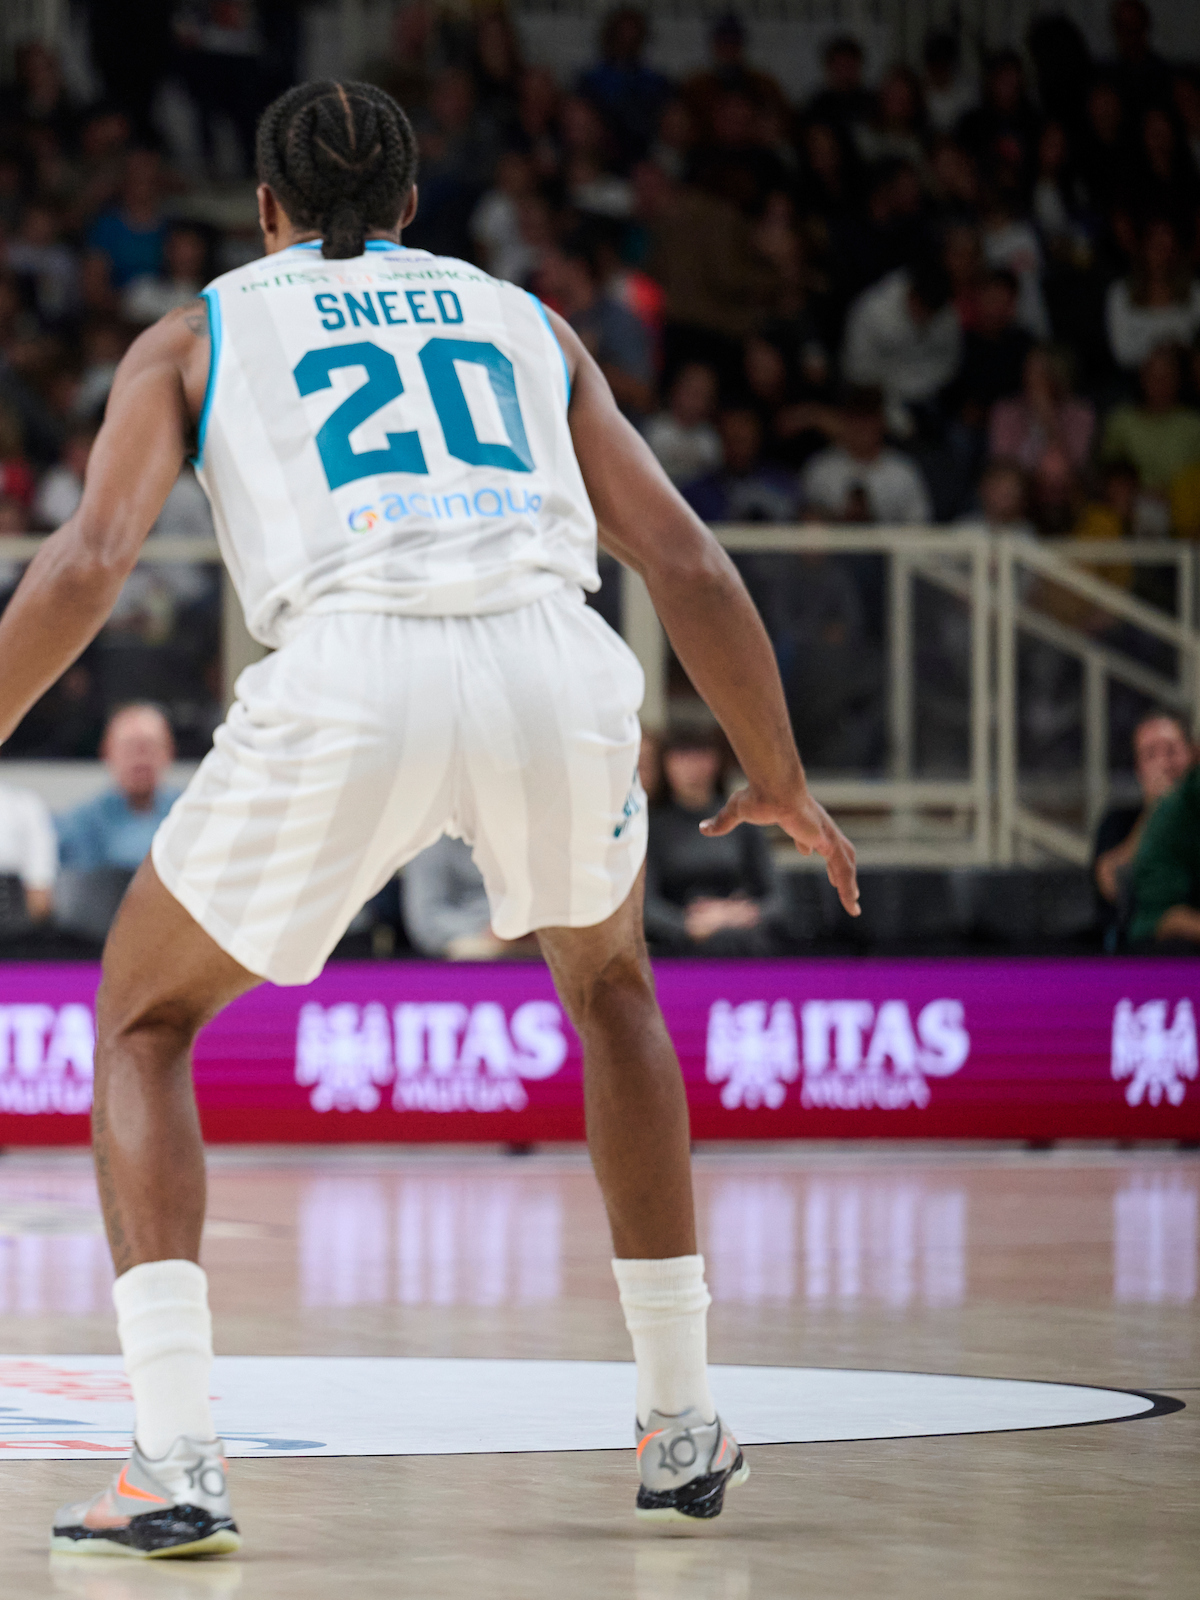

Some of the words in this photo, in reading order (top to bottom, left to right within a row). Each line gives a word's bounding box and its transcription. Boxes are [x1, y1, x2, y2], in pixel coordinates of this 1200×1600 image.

[314, 290, 463, 330] SNEED
[293, 337, 536, 491] 20
[393, 1000, 568, 1081] ITAS
[801, 998, 971, 1078] ITAS
